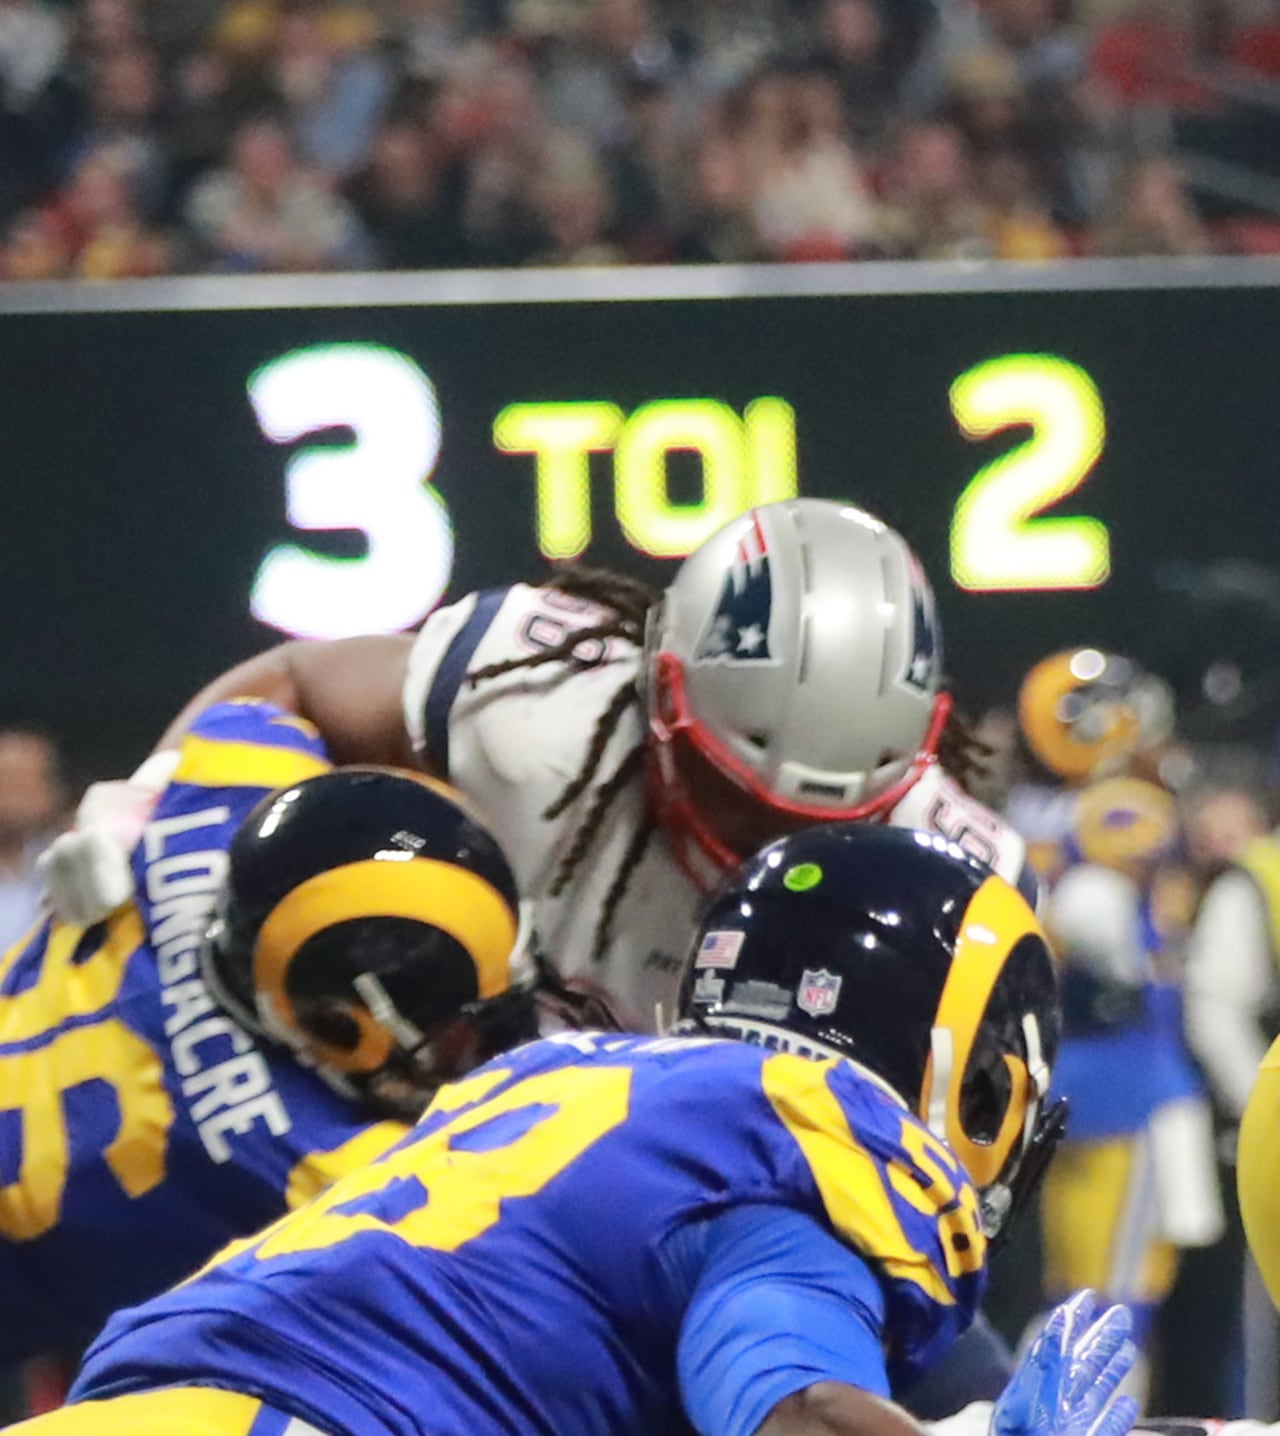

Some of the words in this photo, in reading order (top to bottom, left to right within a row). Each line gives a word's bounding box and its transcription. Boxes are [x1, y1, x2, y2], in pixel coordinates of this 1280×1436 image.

[246, 341, 456, 641] 3
[948, 352, 1112, 594] 2
[144, 805, 292, 1166] LONGACRE
